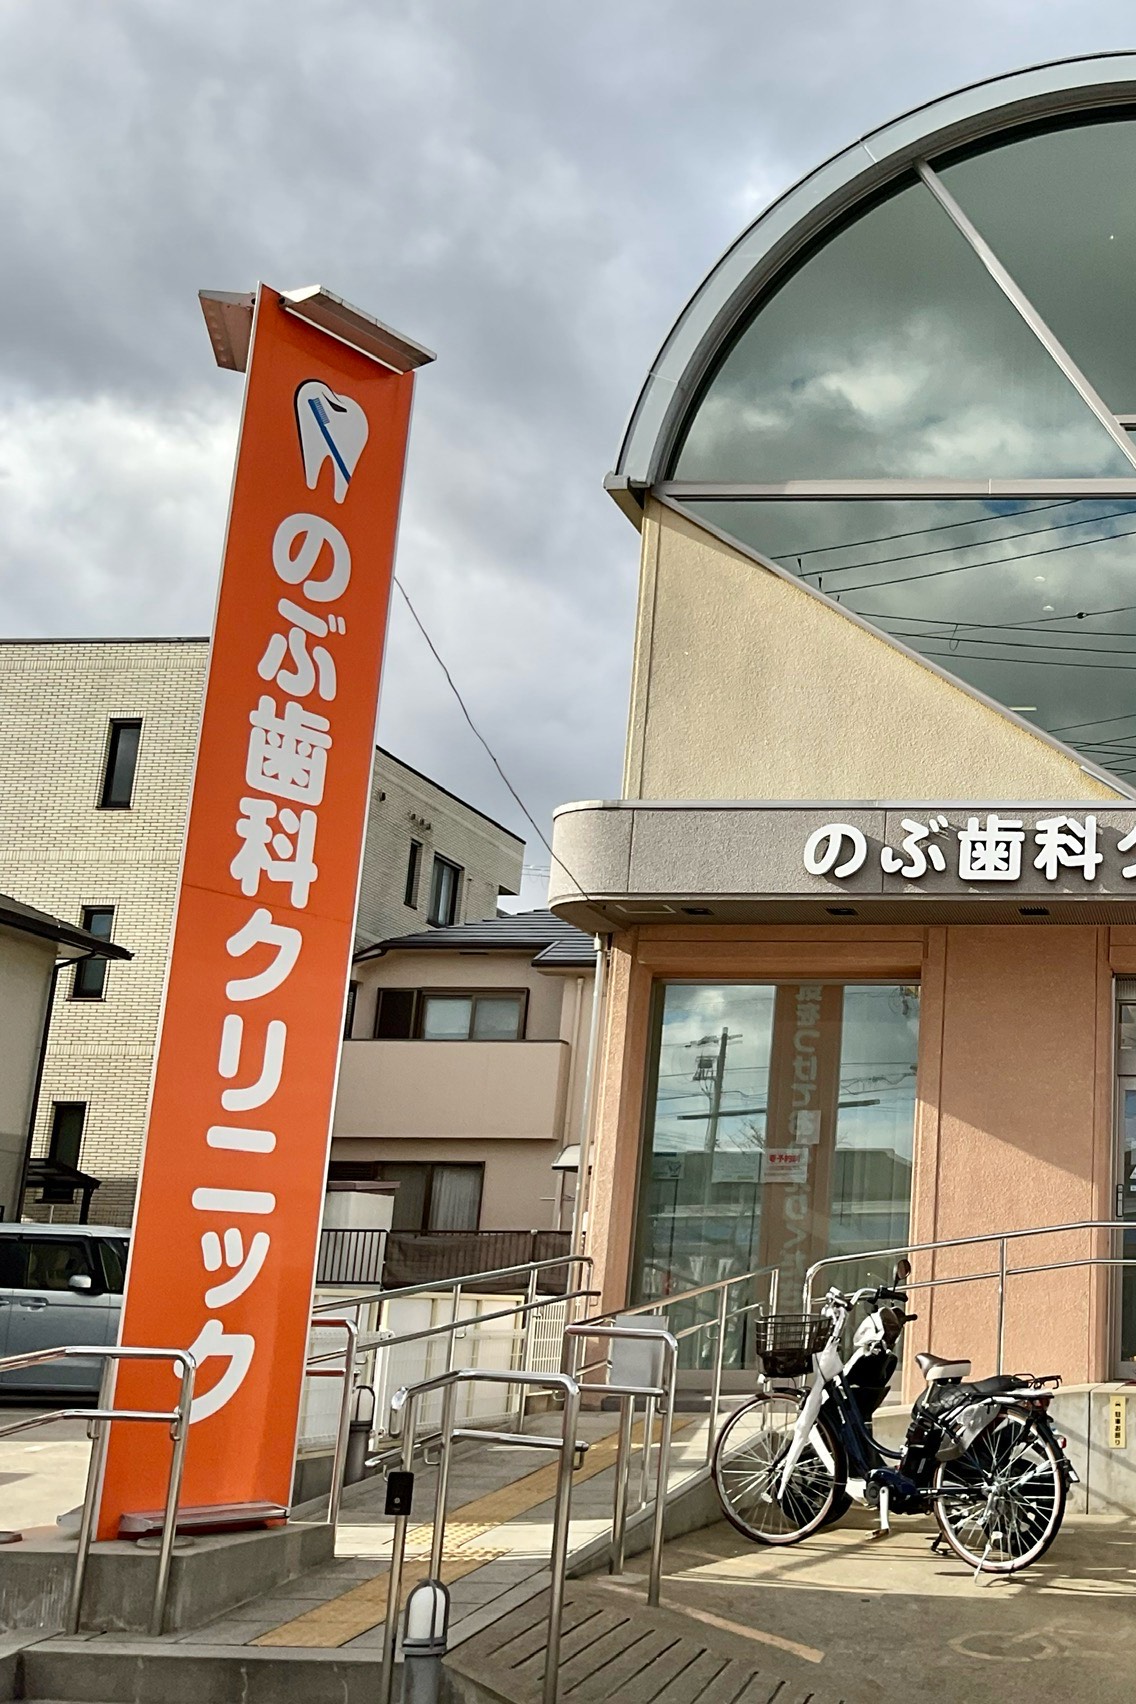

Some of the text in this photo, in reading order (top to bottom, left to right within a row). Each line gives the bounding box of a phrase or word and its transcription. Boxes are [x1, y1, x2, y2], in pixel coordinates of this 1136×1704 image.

[174, 512, 352, 1424] のぶ歯科クリニック
